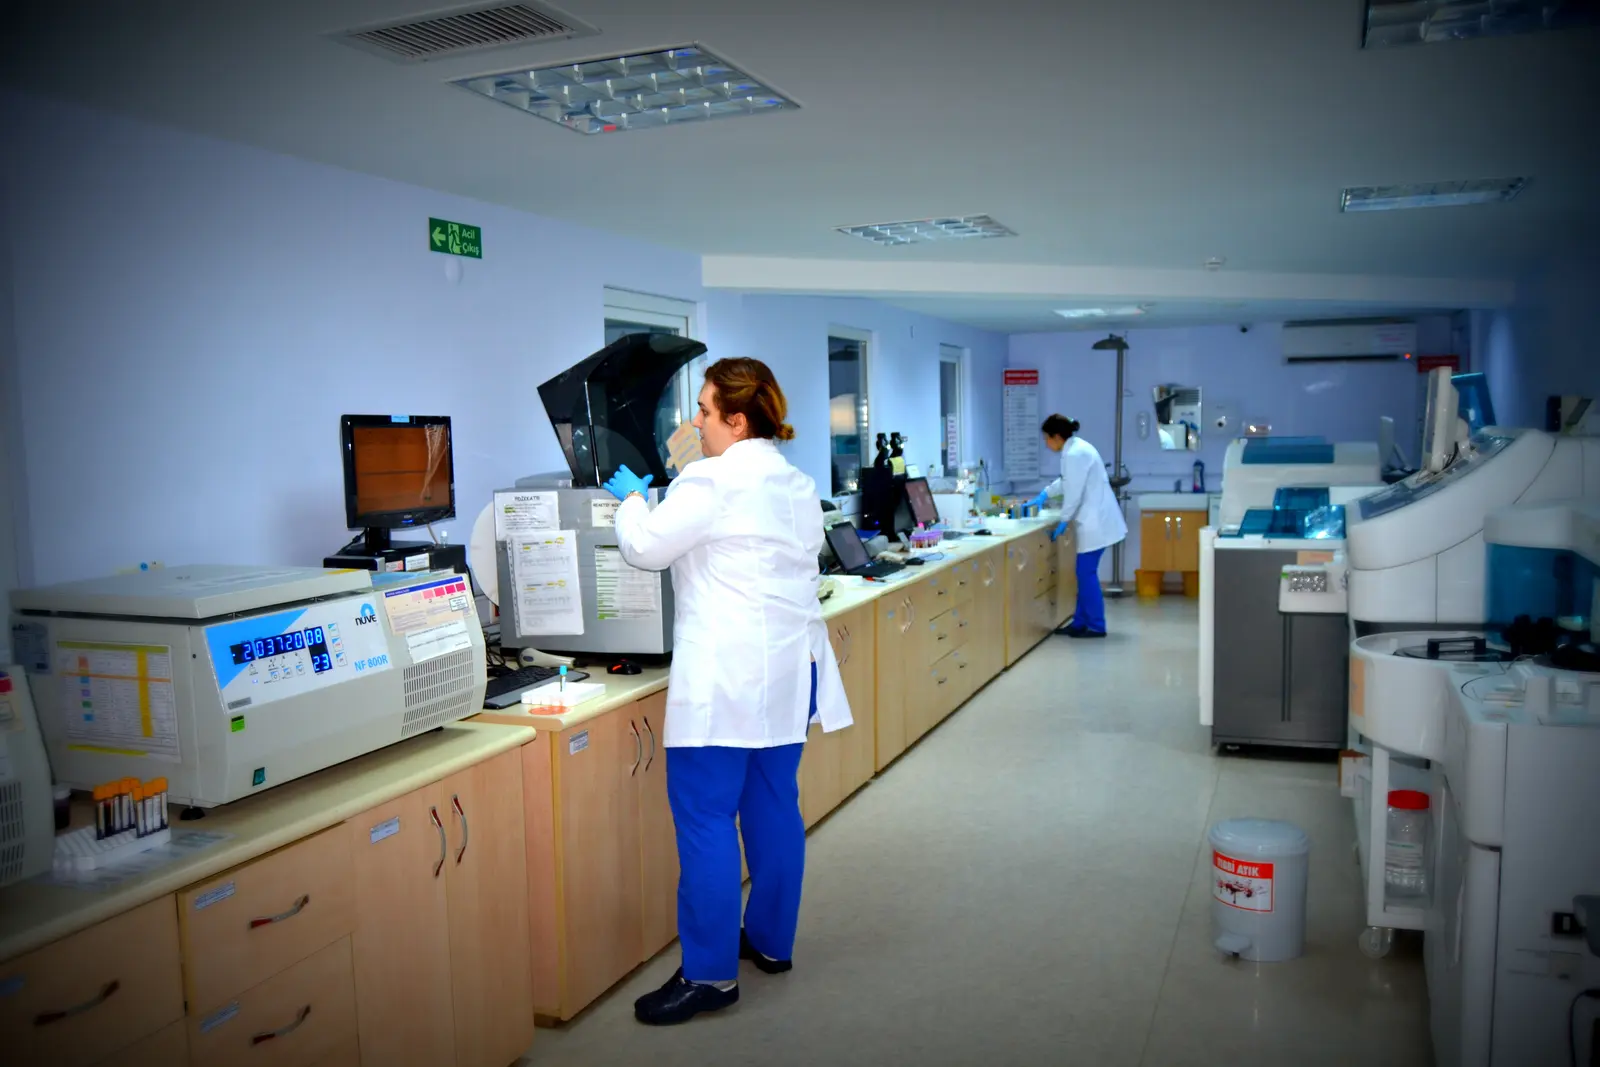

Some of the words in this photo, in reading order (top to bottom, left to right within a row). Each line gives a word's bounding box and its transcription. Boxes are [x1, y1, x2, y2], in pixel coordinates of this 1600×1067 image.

[462, 229, 475, 239] Acil
[462, 242, 480, 255] Çıkış
[313, 653, 330, 671] 23
[354, 660, 367, 672] NF
[367, 654, 389, 668] 800R
[1237, 864, 1260, 876] ATIK
